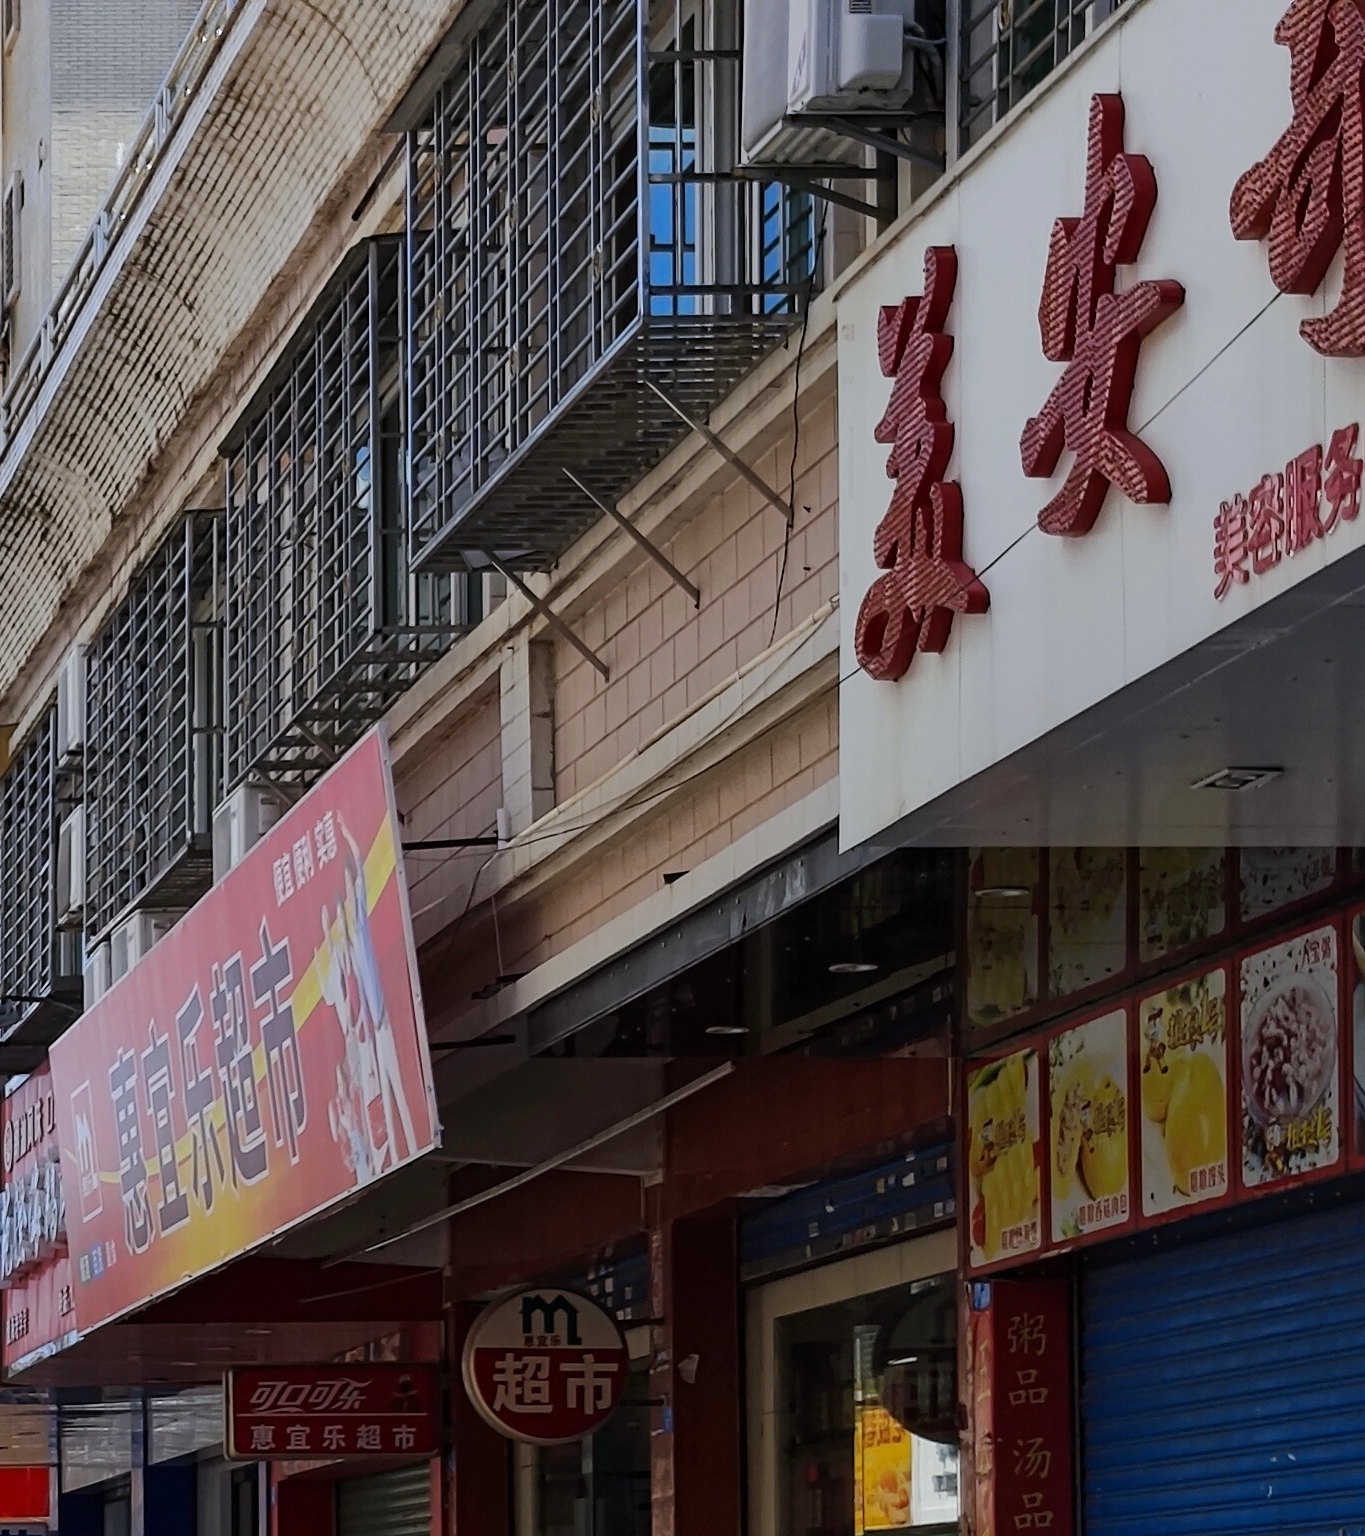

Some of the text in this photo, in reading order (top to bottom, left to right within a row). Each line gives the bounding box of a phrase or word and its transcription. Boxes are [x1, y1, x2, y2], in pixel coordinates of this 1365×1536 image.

[1213, 423, 1365, 600] 美容服务
[314, 811, 338, 871] 实惠
[108, 916, 308, 1256] 惠宜乐超市
[249, 1377, 374, 1414] 可口可乐
[493, 1353, 619, 1415] 超市
[1006, 1313, 1049, 1407] 粥品
[250, 1424, 417, 1451] 惠宜乐超市
[1012, 1437, 1054, 1531] 汤品
